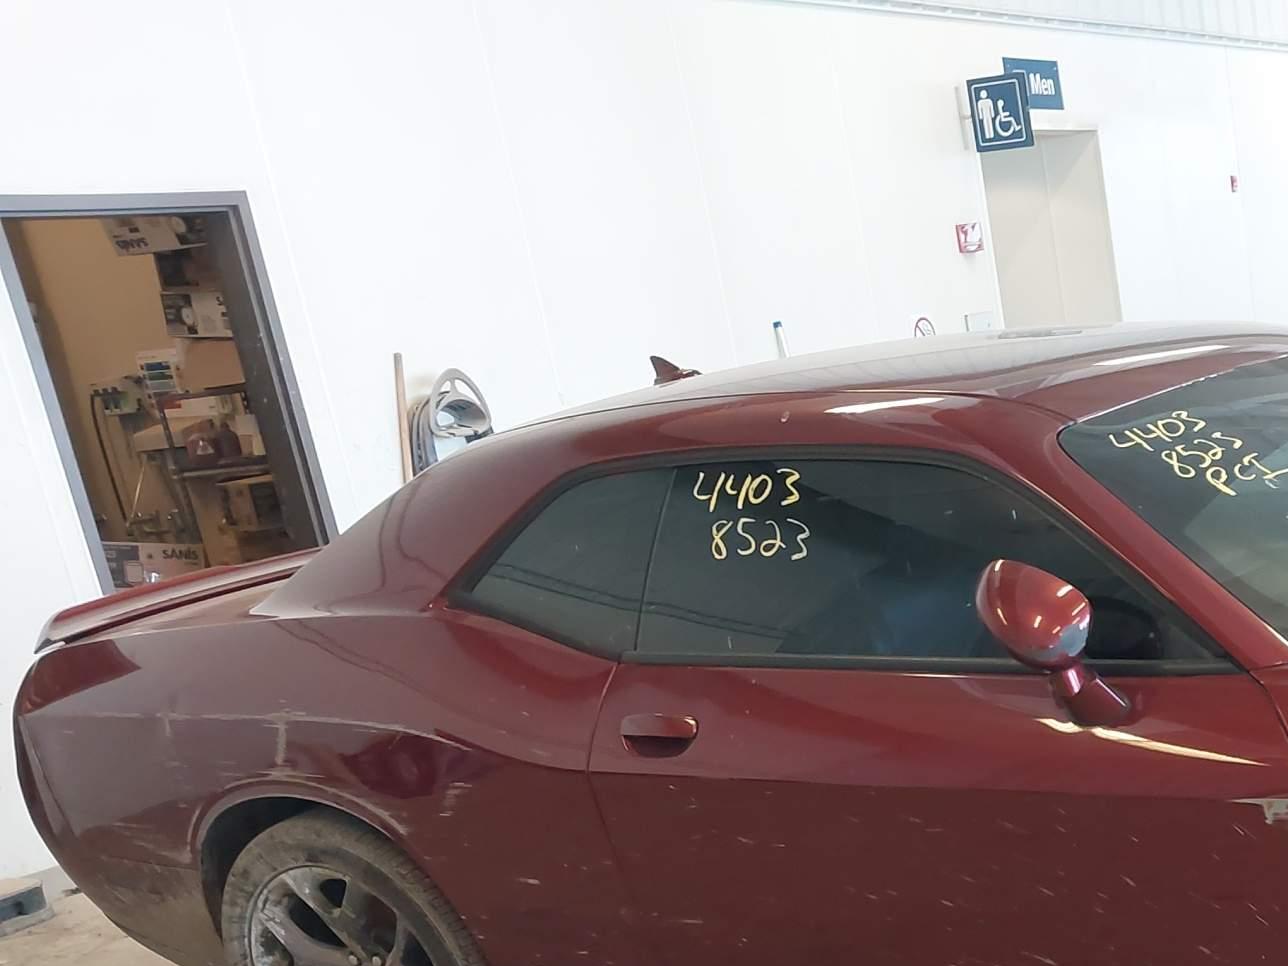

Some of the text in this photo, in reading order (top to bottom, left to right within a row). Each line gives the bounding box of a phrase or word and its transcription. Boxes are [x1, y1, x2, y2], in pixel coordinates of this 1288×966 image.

[1029, 72, 1056, 95] Men
[1108, 410, 1207, 452] 4403
[1161, 431, 1244, 478] 8523
[693, 468, 801, 512] 4403
[711, 517, 811, 560] 8523
